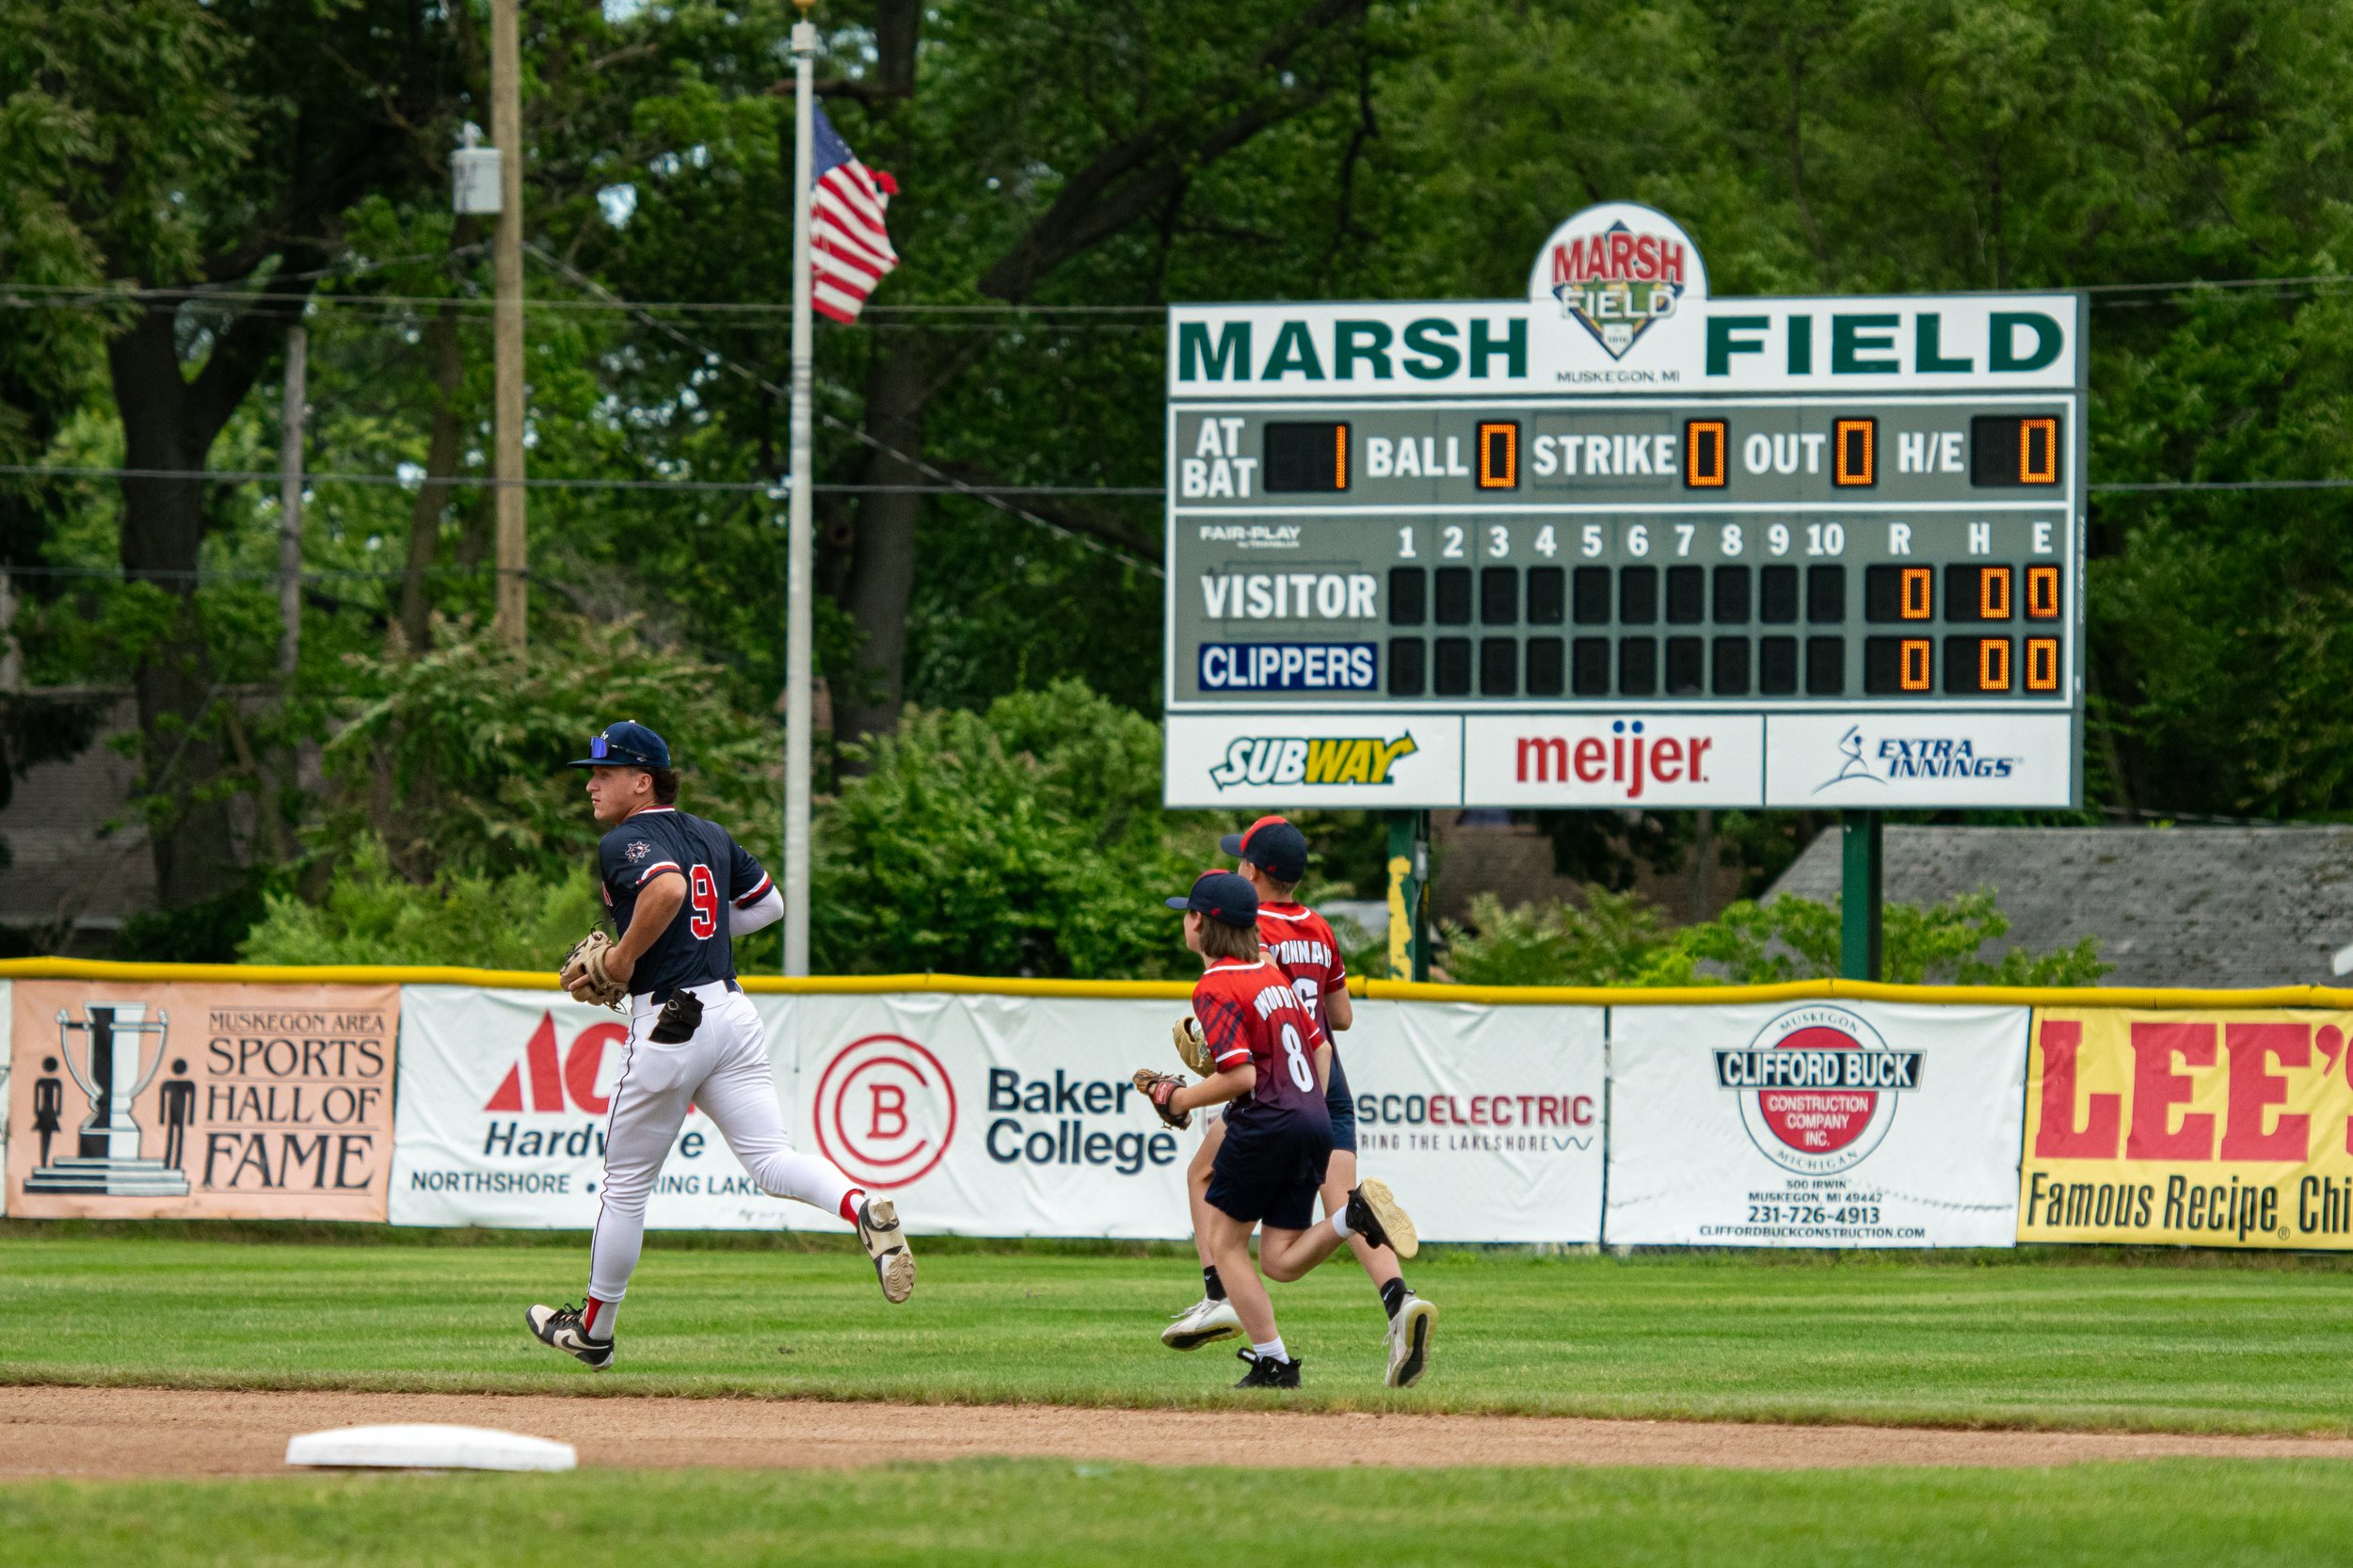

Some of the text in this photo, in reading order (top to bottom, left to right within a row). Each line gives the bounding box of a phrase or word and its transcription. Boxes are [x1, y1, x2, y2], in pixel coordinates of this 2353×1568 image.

[1552, 231, 1685, 283] MARSH
[1561, 286, 1677, 318] FIELD
[1178, 312, 2064, 381] MARSH FIELD
[1662, 370, 1680, 381] MI
[1196, 417, 1244, 456] AT
[1366, 437, 1469, 476] BALL
[1481, 424, 1515, 488] 0
[1533, 434, 1678, 475] STRIKE
[1689, 422, 1724, 486] 0
[1744, 433, 1826, 474] OUT
[1837, 421, 1872, 485] 0
[1897, 432, 1964, 472] H/E
[2020, 419, 2056, 483] 0
[1181, 458, 1258, 497] BAT
[1399, 522, 2053, 558] 1 2 3 4 5 6 7 8 9 10 R H E
[1201, 574, 1377, 619] VISITOR
[1901, 568, 2057, 618] 0 0 0
[1202, 647, 1374, 687] CLIPPERS
[1900, 639, 2057, 690] 0 0 0
[1214, 732, 1412, 789] SUBWAY
[1516, 721, 1712, 797] meijer
[1879, 739, 1975, 759] EXTRA
[1889, 757, 2015, 777] INNINGS
[689, 864, 718, 940] 9
[1291, 977, 1318, 1021] 6
[210, 1013, 386, 1032] MUSKEGON AREA
[1780, 1012, 1860, 1033] MUSKEGON
[206, 1038, 384, 1078] SPORTS
[484, 1010, 695, 1114] AC
[1281, 1022, 1315, 1094] 8
[1724, 1052, 1912, 1087] CLIFFORD BUCK
[207, 1084, 381, 1125] HALL OF
[987, 1067, 1134, 1114] Baker
[1357, 1095, 1593, 1126] SCOELECTRIC
[1768, 1096, 1869, 1112] CONSTRUCTION
[2035, 1020, 2353, 1163] LEE'
[483, 1121, 705, 1158] Harde
[1785, 1113, 1849, 1129] COMPANY
[1805, 1130, 1831, 1146] INC.
[201, 1132, 375, 1192] FAME
[985, 1117, 1177, 1176] College
[1360, 1135, 1549, 1151] RING THE LAKESHORE
[1778, 1150, 1858, 1170] MICHIGAN
[410, 1172, 570, 1193] NORTHSHORE
[1813, 1180, 1847, 1189] IRWIN
[1827, 1192, 1842, 1202] MI
[1845, 1192, 1882, 1203] 49442
[1749, 1206, 1881, 1224] 231-726-4913
[2026, 1172, 2155, 1228] Famous
[2163, 1174, 2279, 1242] Recipe
[1699, 1225, 1925, 1239] CLIFFORDBUCKCONSTRUCTION.COM
